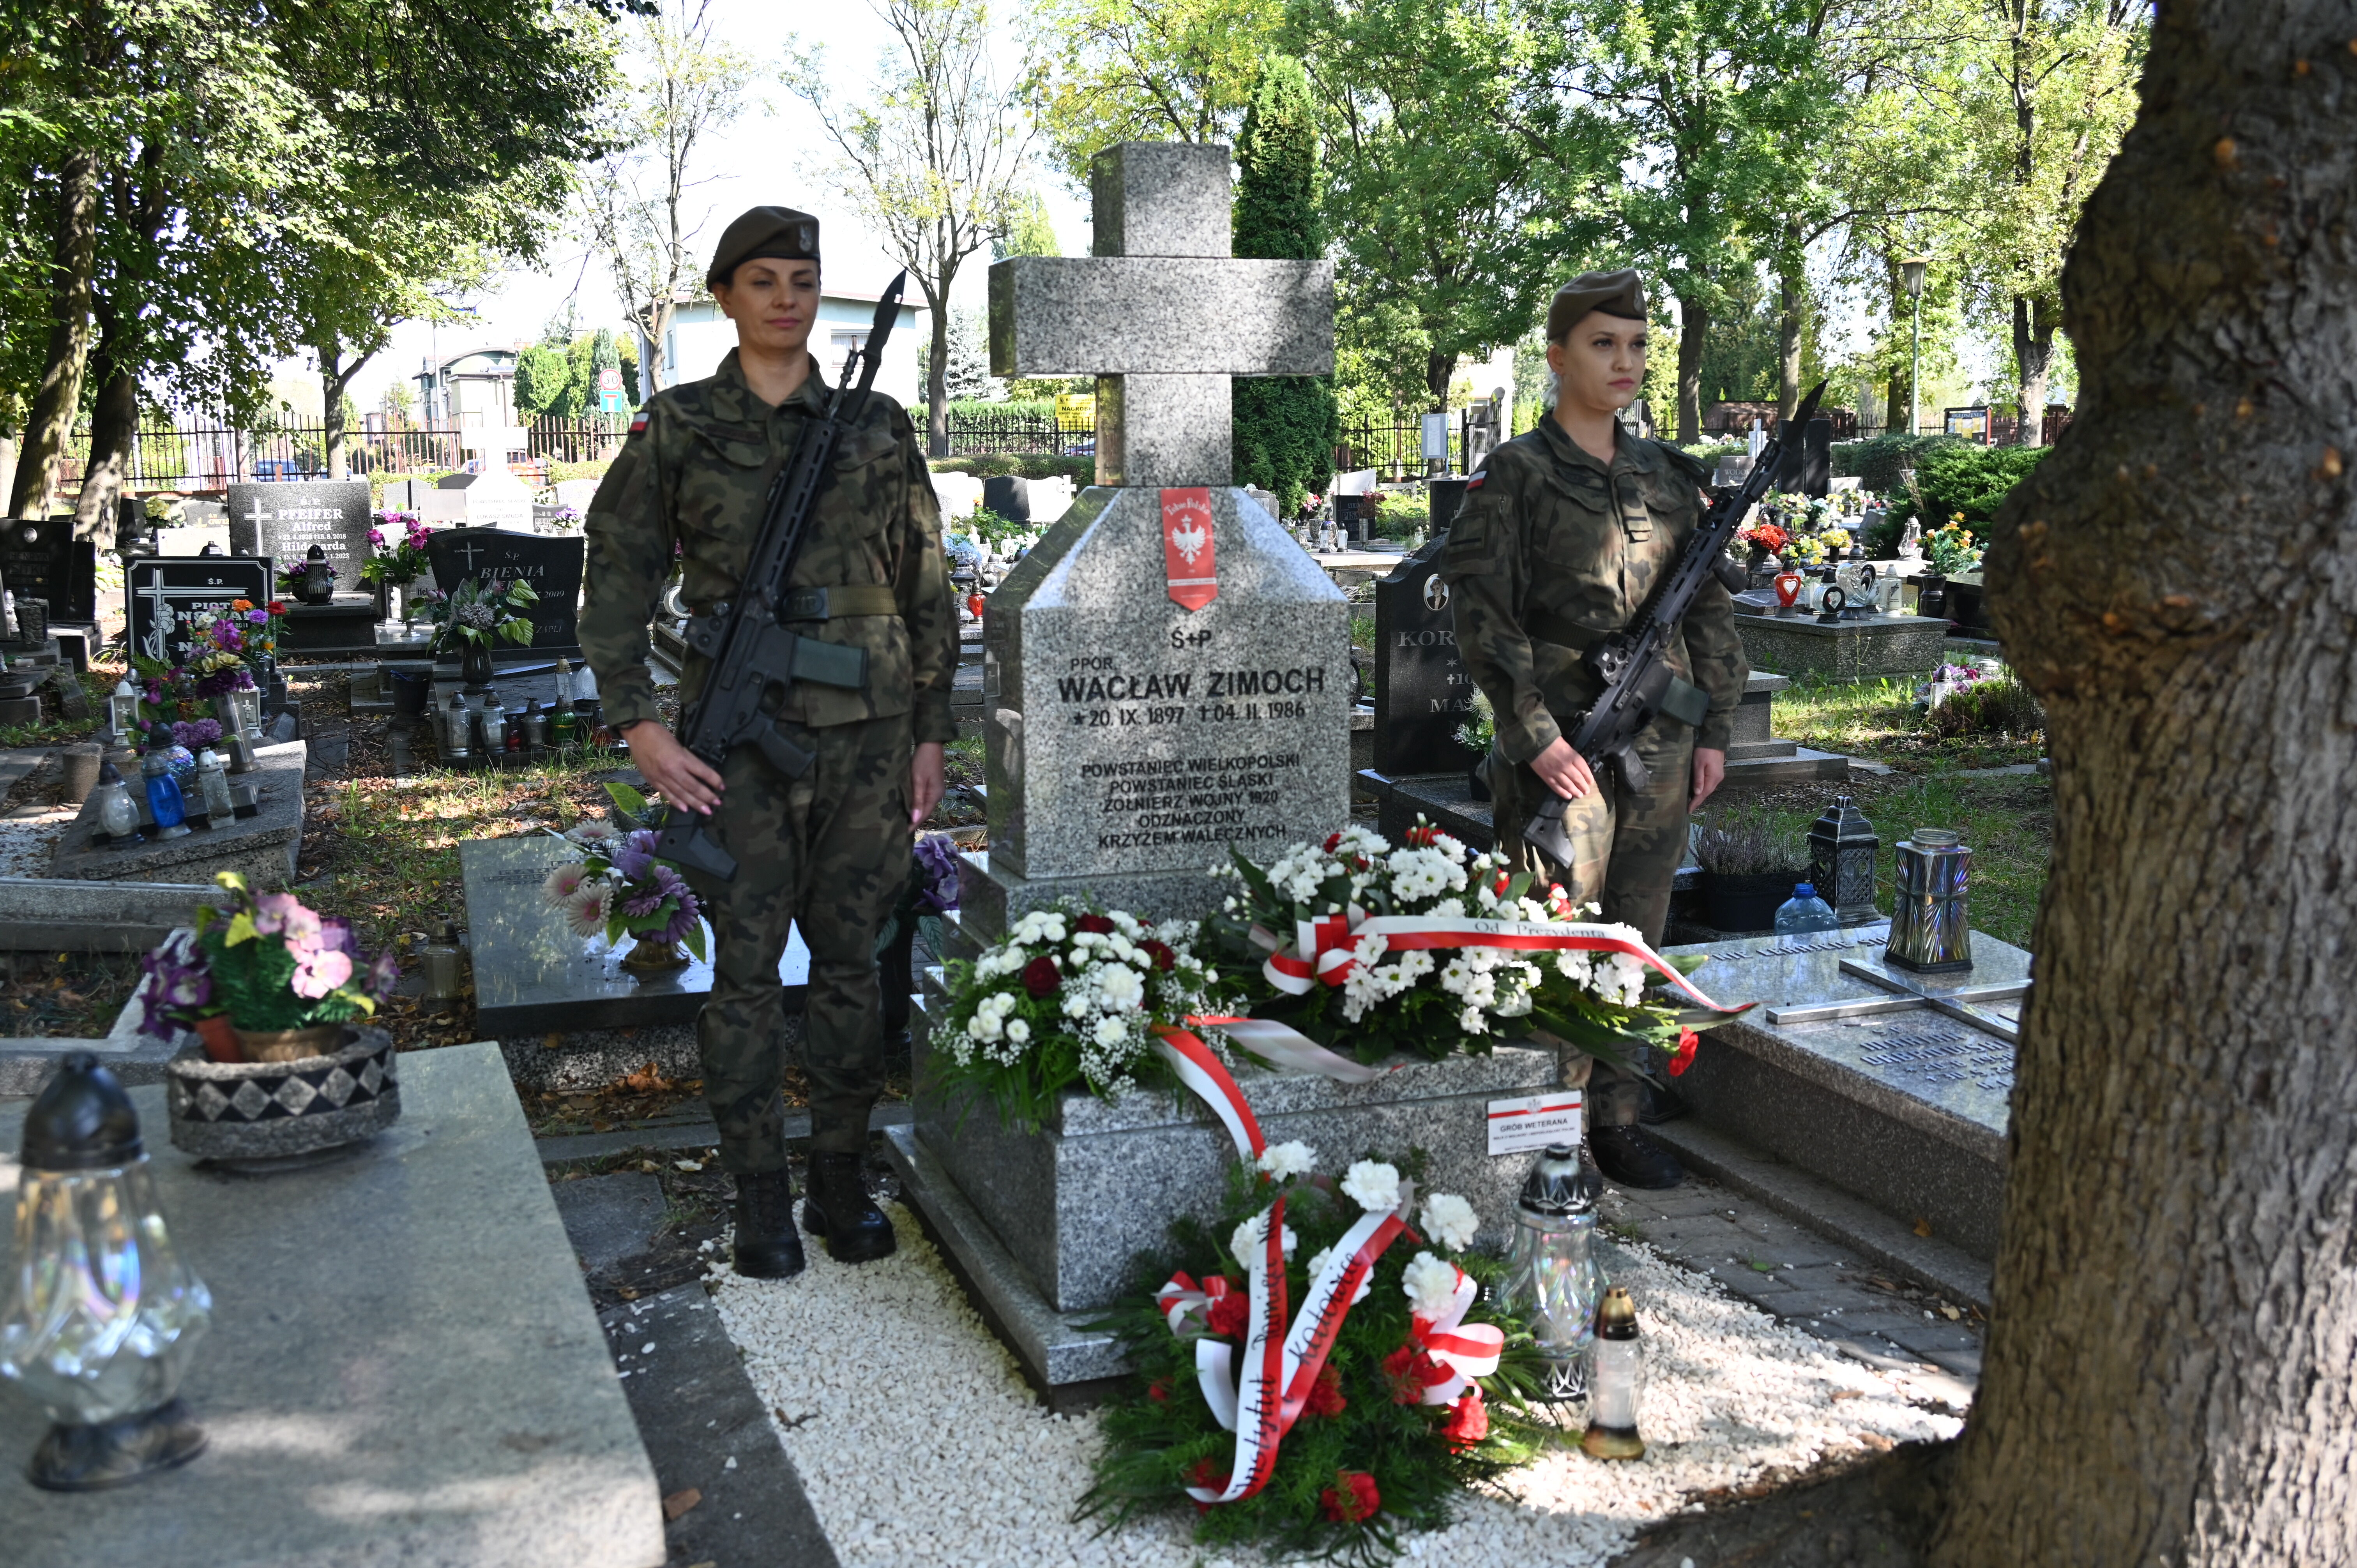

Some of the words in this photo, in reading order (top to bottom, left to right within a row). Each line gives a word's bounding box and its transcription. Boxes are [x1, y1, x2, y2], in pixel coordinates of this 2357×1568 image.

[604, 375, 618, 384] 30
[278, 509, 343, 520] PFEIFER
[292, 521, 331, 531] Alfred
[10, 564, 49, 574] SITKO
[481, 565, 544, 579] BIENIA
[1058, 674, 1191, 702] WACŁAW
[1207, 667, 1324, 697] ZIMOCH
[1149, 706, 1185, 724] 1897
[1268, 701, 1305, 719] 1986
[1082, 760, 1184, 778] POWSTANIEC
[1189, 754, 1299, 772] WIELKOPOLSKI
[1111, 776, 1213, 794] POWSTANIEC
[1189, 791, 1243, 807] WOJNY
[1249, 790, 1278, 804] 1920
[1139, 809, 1245, 828] ODZNACZONY
[1182, 824, 1286, 843] WALECZNYCH
[1475, 921, 1500, 933] Od
[1516, 924, 1605, 939] Prezydenta
[1500, 1123, 1523, 1133] GRÓB
[1525, 1118, 1568, 1129] WETERANA
[1288, 1252, 1363, 1368] Katowice
[1231, 1373, 1278, 1497] Instytut
